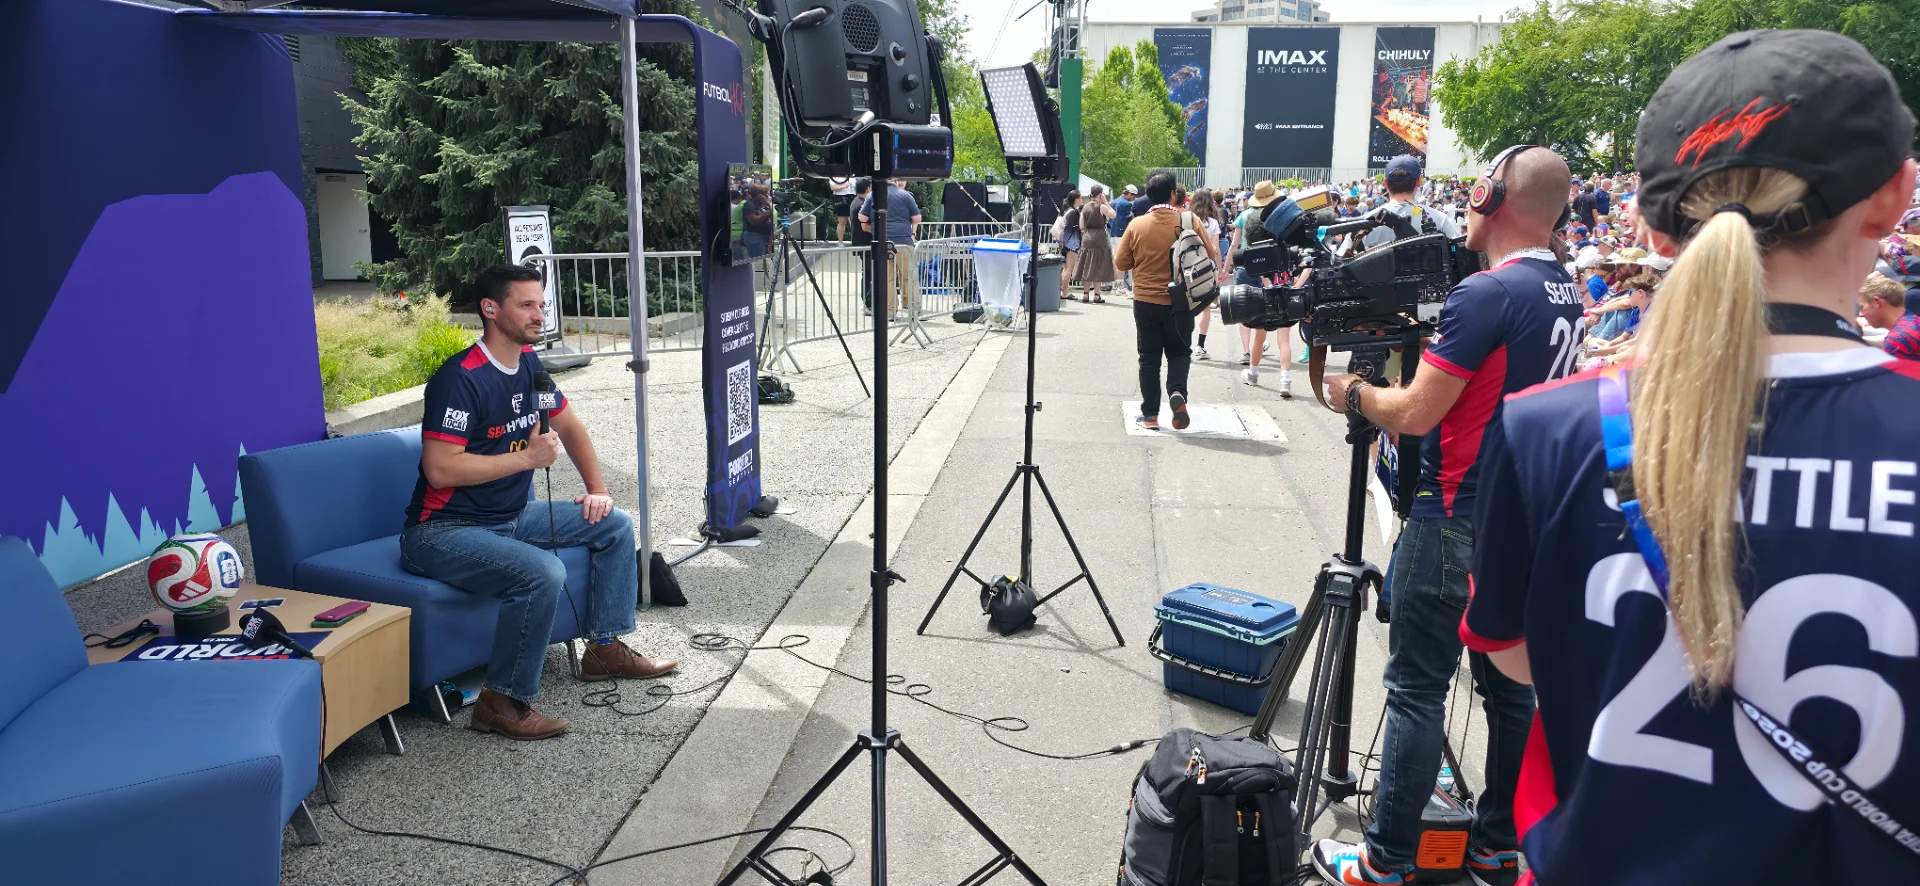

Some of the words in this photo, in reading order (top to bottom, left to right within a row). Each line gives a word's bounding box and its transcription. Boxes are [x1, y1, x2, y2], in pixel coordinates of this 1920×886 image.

[1257, 50, 1327, 65] IMAX
[1378, 49, 1431, 60] CHIHULY
[1544, 316, 1586, 384] 26
[539, 393, 555, 401] FOX
[442, 416, 468, 432] LOCAL
[445, 407, 470, 420] FOX
[138, 643, 293, 660] WORLD
[1585, 551, 1919, 812] 26
[1742, 702, 1813, 763] 2026
[1805, 760, 1847, 792] CUP
[1840, 789, 1902, 835] WORLD
[1895, 828, 1920, 856] FIFA
